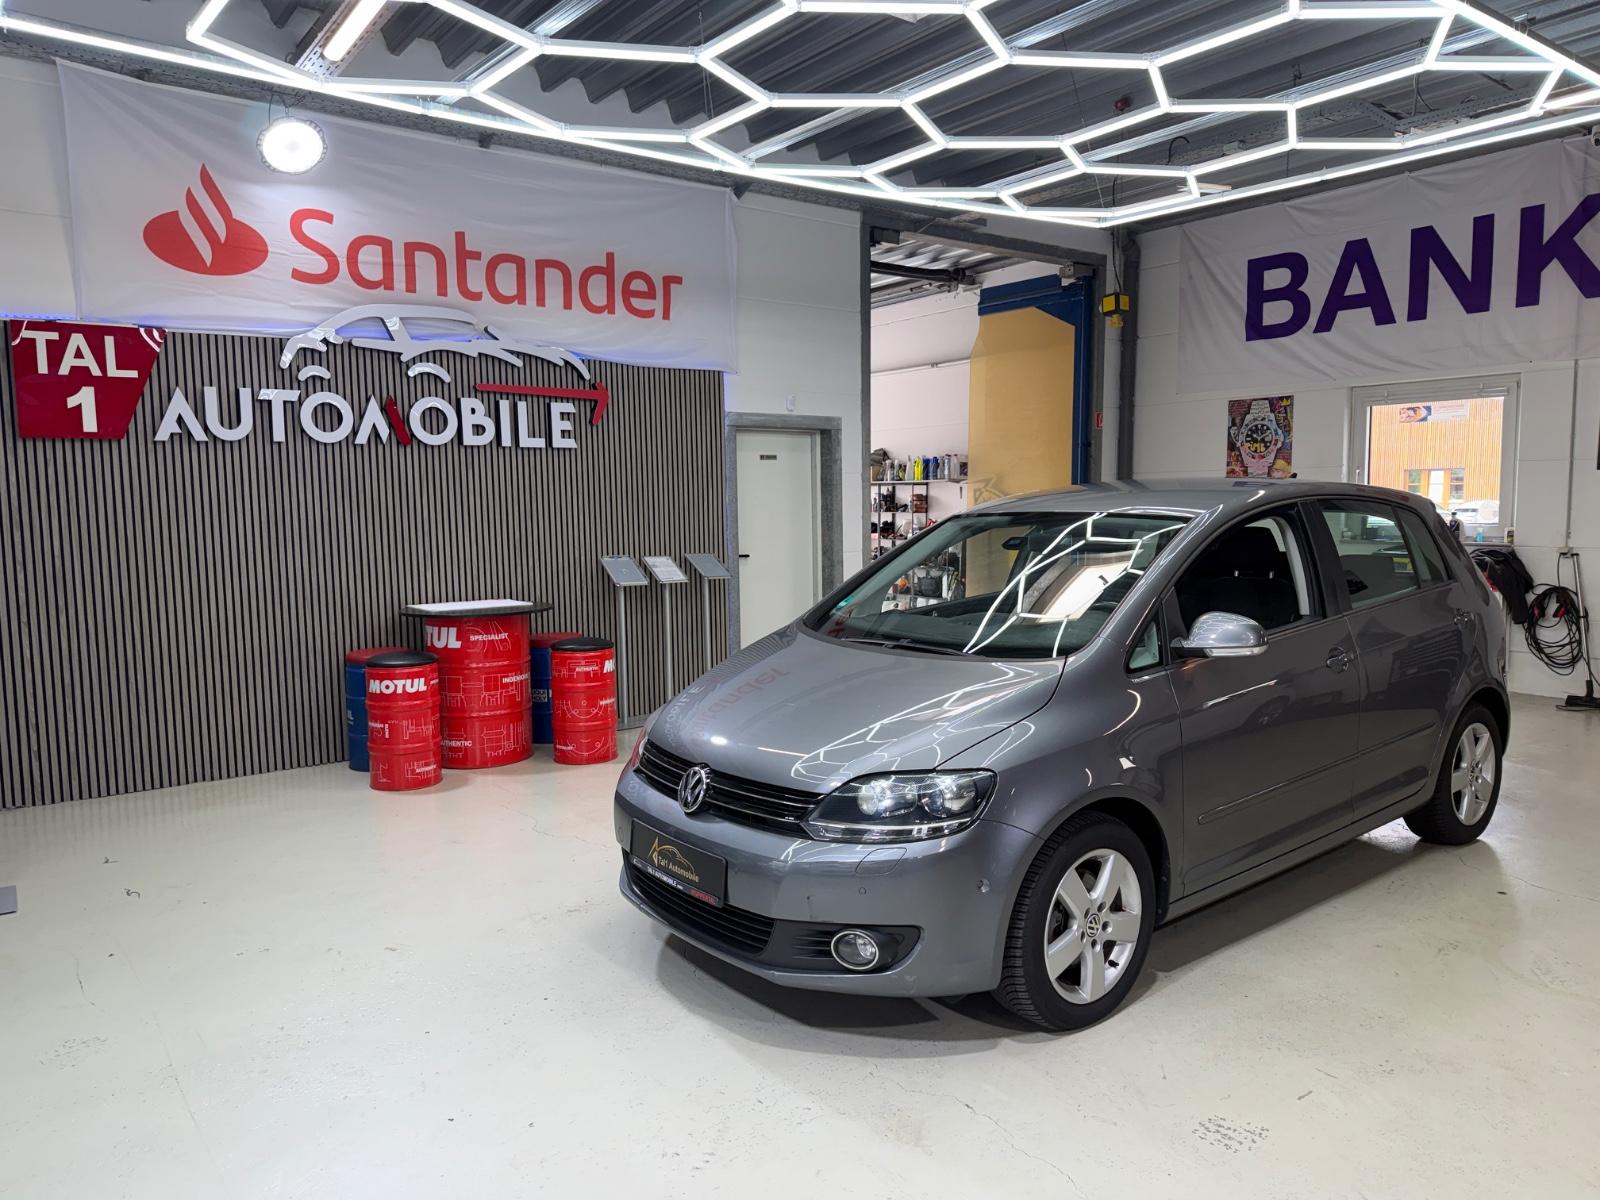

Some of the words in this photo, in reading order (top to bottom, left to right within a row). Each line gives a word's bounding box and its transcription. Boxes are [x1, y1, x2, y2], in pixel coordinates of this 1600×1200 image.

[289, 207, 683, 321] Santander
[1245, 192, 1600, 342] BANK
[20, 330, 139, 380] TAL
[65, 386, 99, 433] 1
[154, 384, 578, 450] AUTOMOBILE
[425, 626, 462, 649] TUL
[469, 632, 509, 641] SPECIALIST
[368, 677, 428, 695] MOTUL
[669, 862, 700, 883] Automobile
